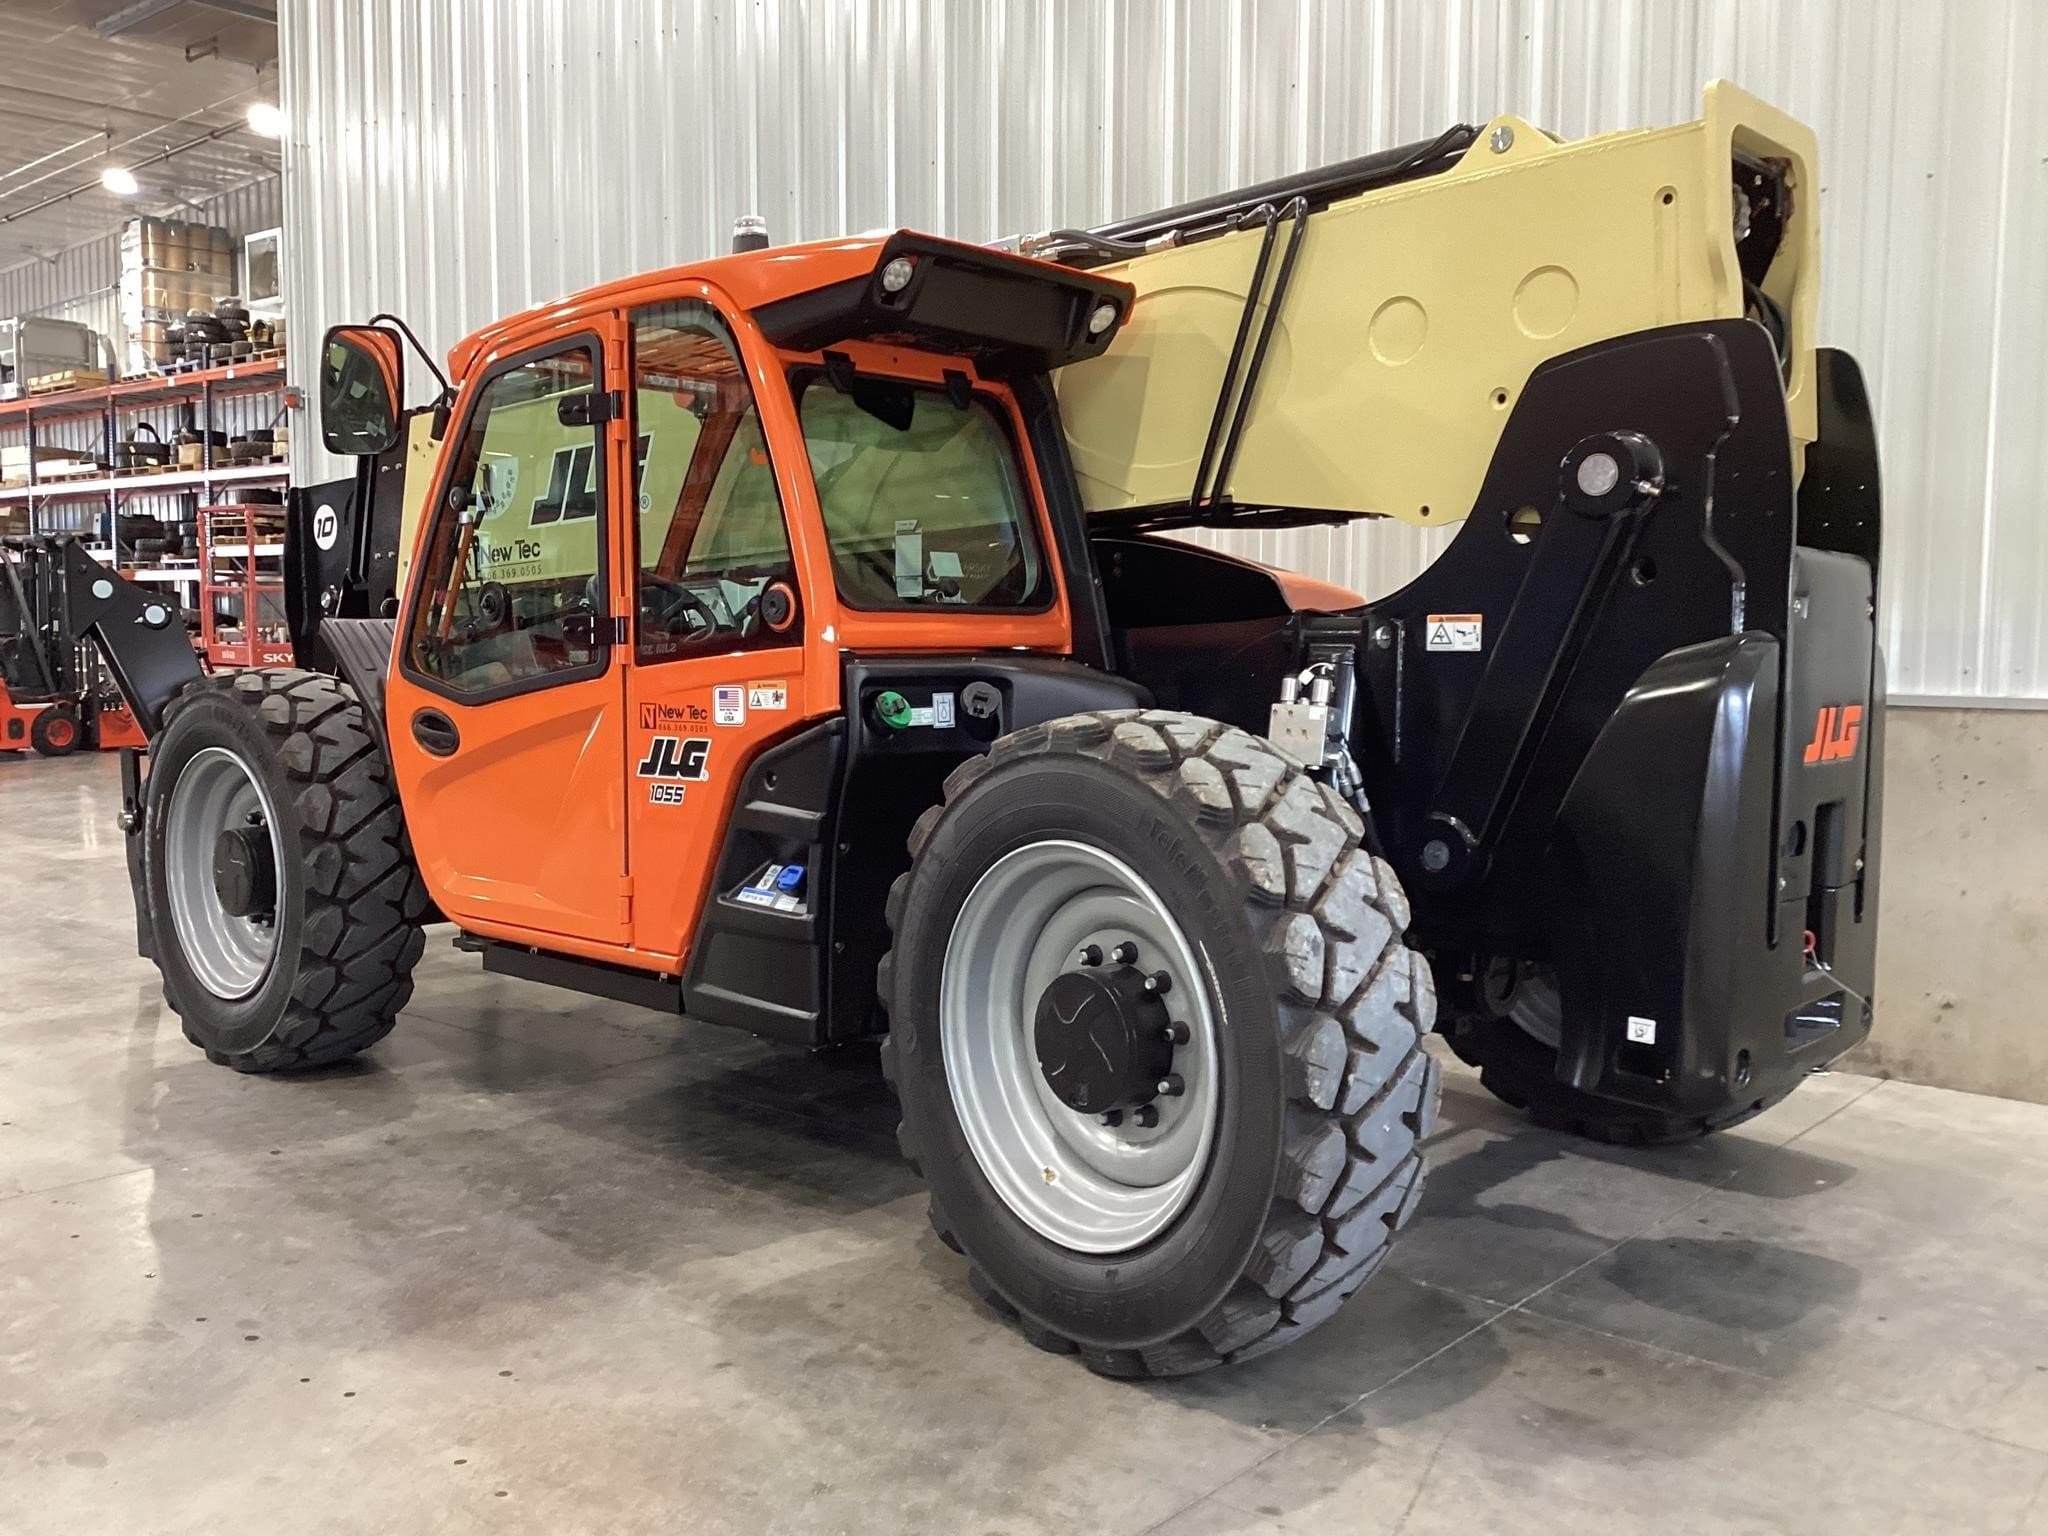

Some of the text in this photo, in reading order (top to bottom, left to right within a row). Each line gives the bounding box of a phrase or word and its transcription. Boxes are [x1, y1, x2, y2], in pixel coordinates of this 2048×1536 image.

[317, 516, 334, 539] 10
[480, 539, 541, 565] New Tec
[658, 703, 708, 720] New Tec
[1803, 705, 1863, 764] JLG
[638, 738, 711, 780] JLG
[650, 784, 684, 803] 1055
